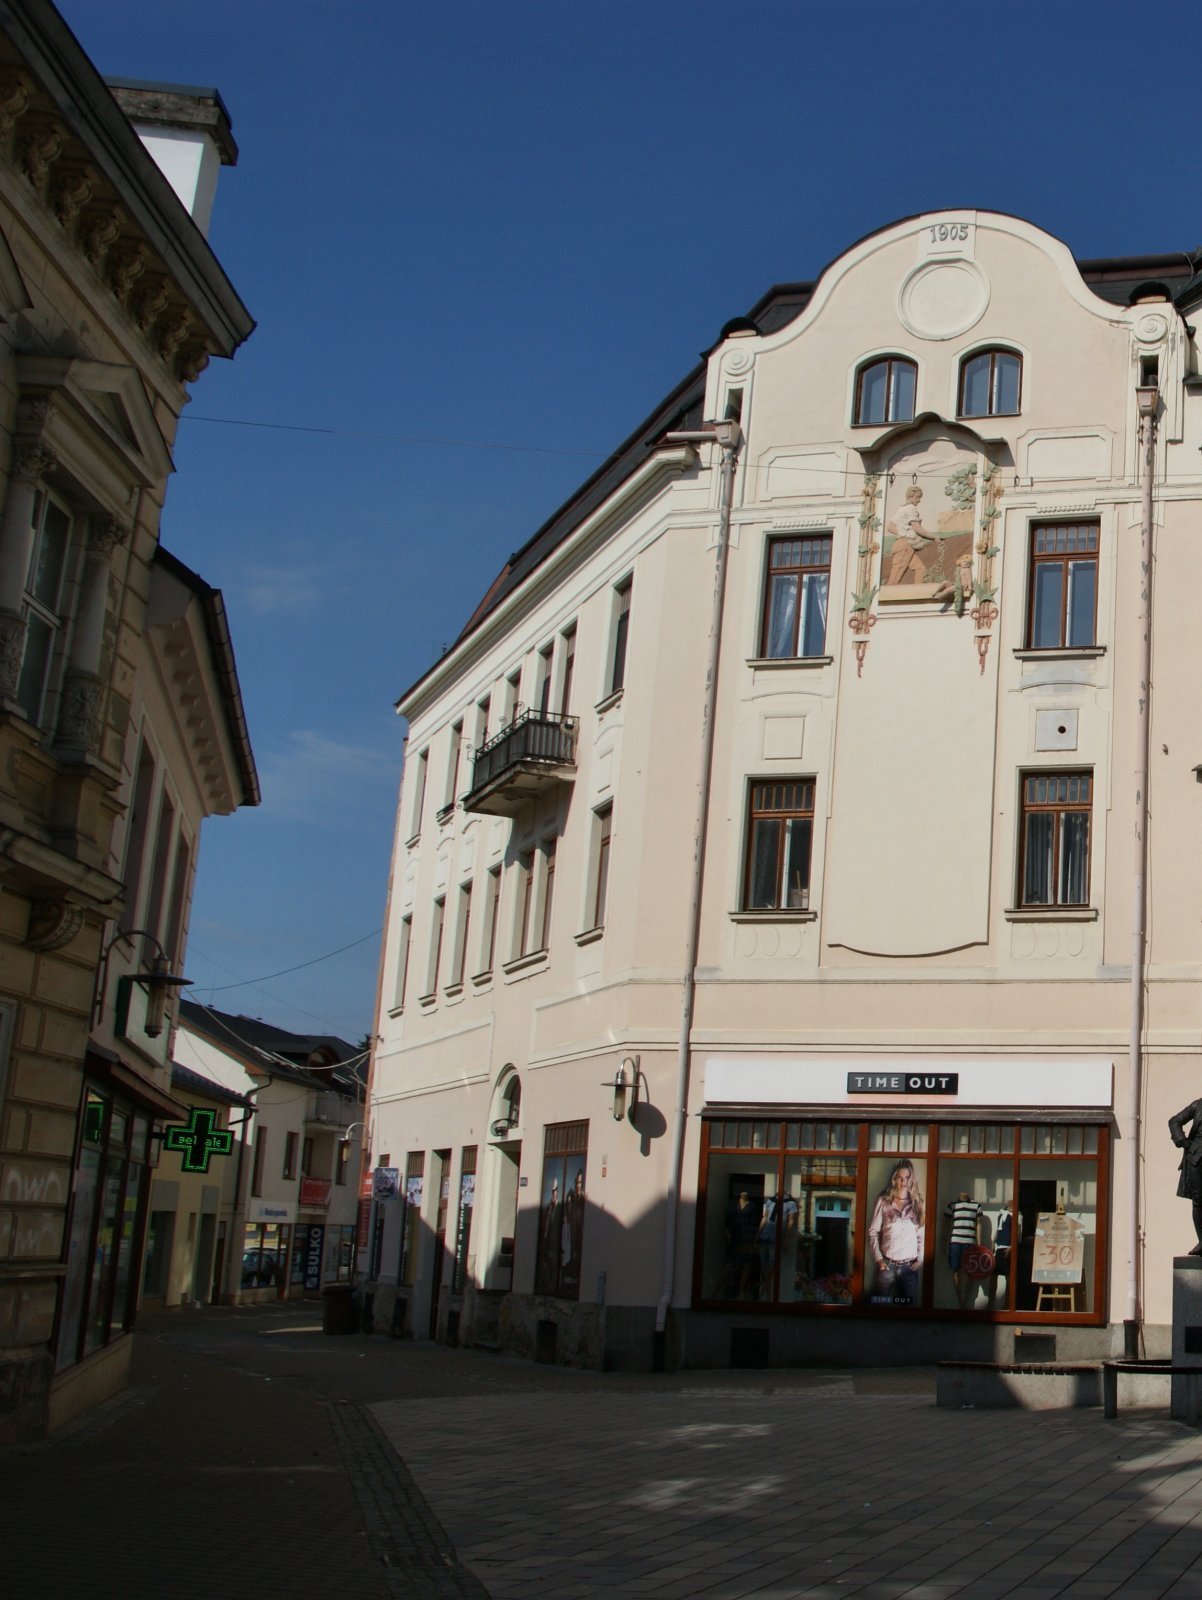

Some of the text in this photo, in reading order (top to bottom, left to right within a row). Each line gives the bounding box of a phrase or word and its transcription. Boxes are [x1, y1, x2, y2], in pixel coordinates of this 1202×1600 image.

[930, 224, 968, 243] 1905
[855, 1077, 950, 1088] TIME OUT
[307, 1226, 322, 1275] SULKO
